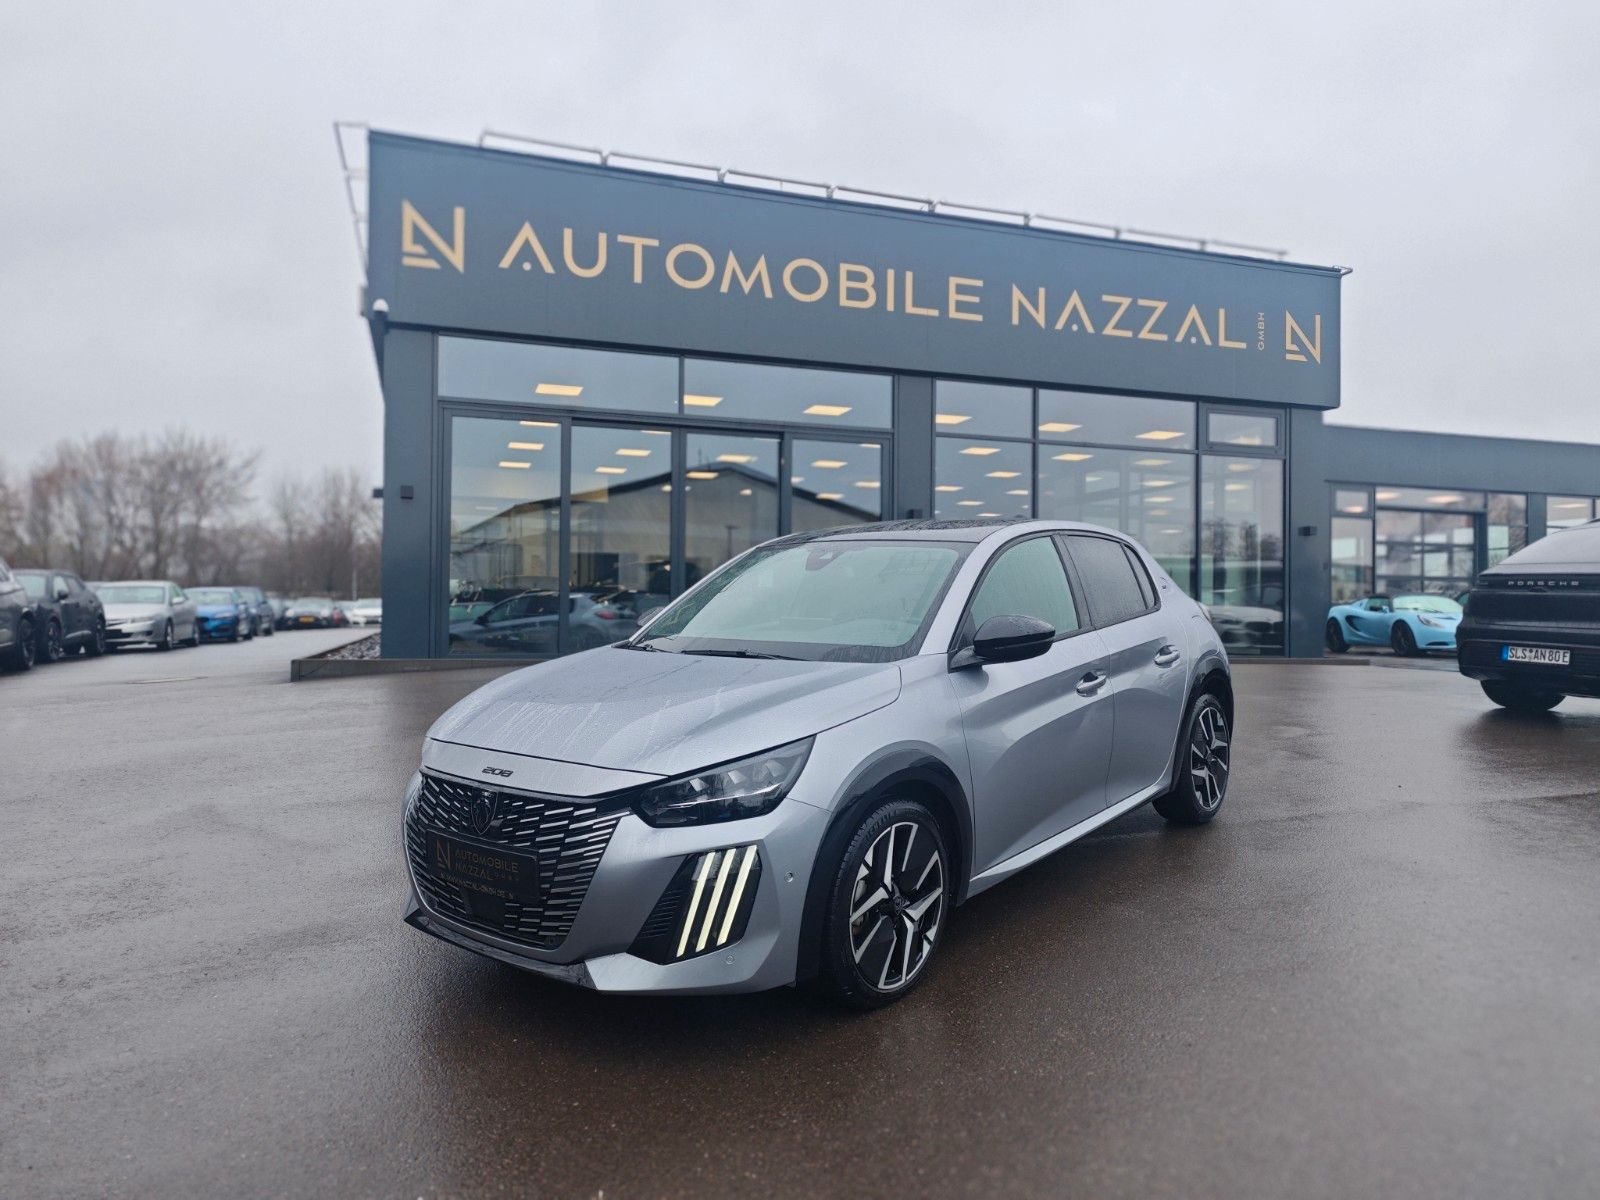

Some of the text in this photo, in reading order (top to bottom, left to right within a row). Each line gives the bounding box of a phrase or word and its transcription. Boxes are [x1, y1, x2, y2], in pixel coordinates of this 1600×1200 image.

[498, 220, 1248, 350] AUTOMOBILE NAZZAL
[1256, 311, 1266, 352] GMBH
[1509, 647, 1527, 660] SLS
[1533, 649, 1547, 661] AN
[481, 766, 513, 778] 208
[454, 849, 519, 873] AUTOMOBILE
